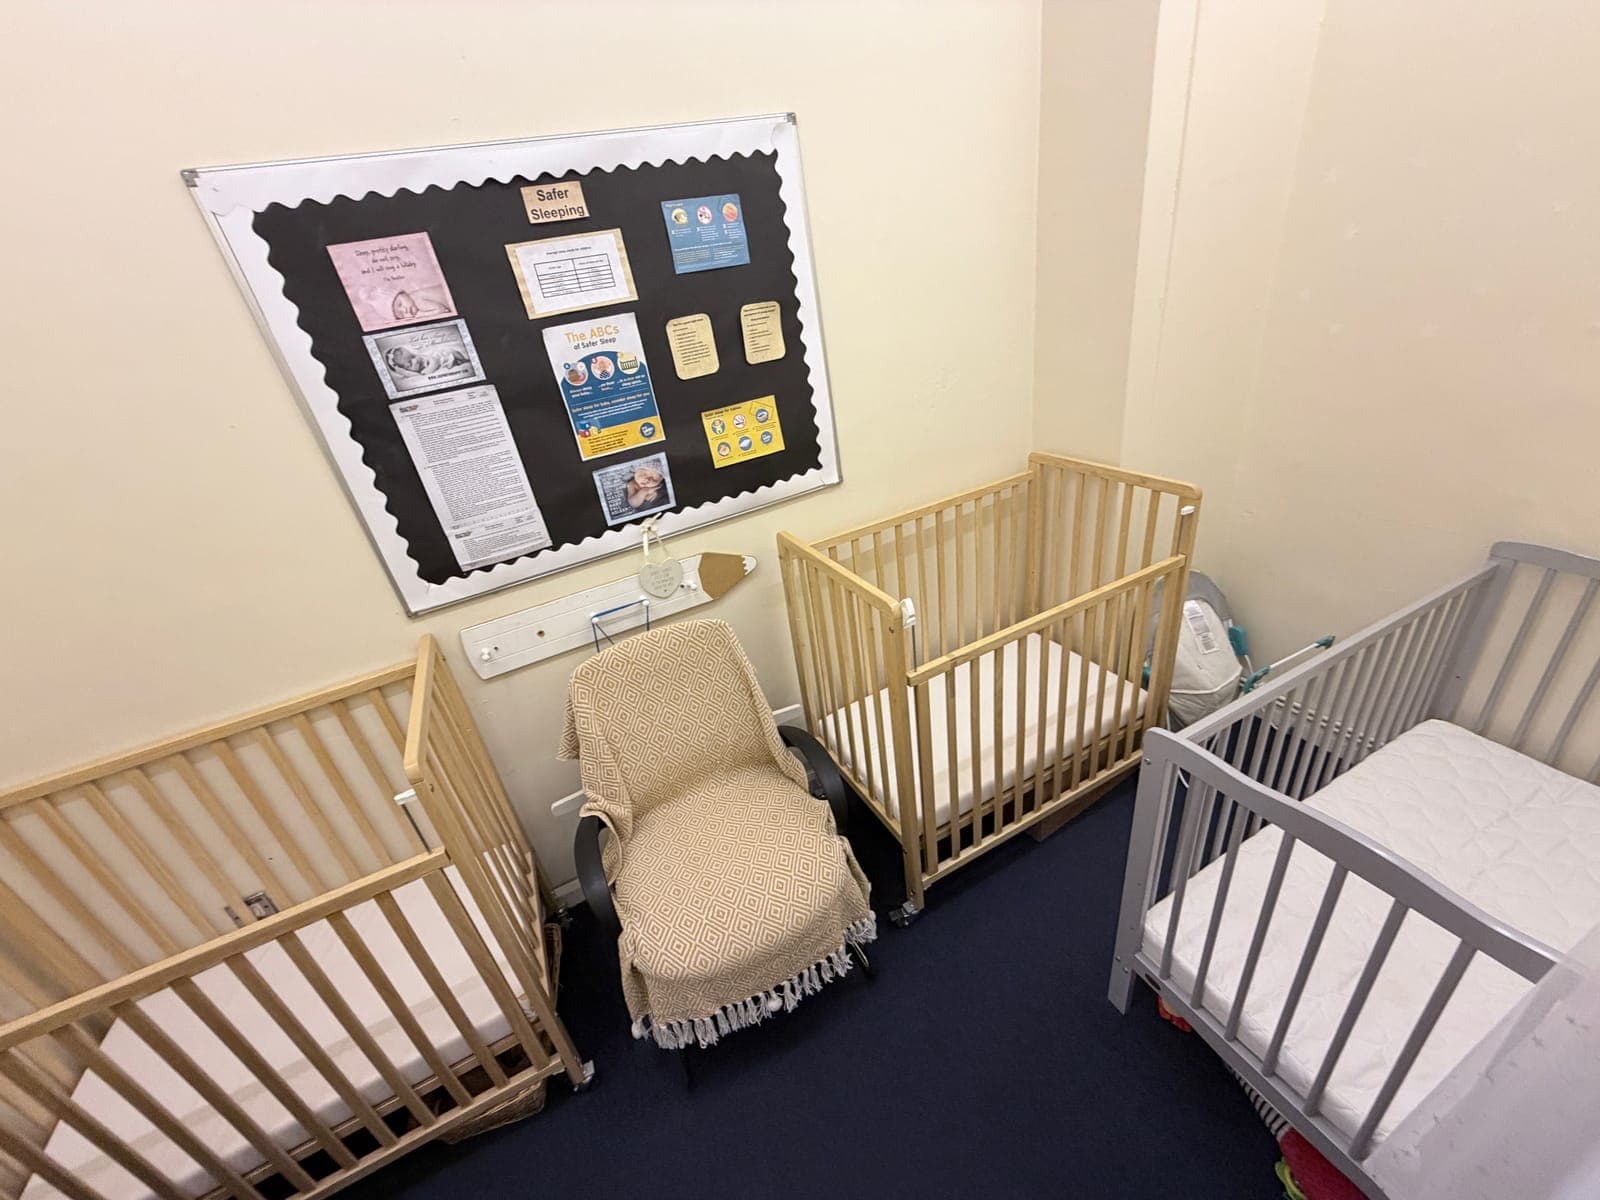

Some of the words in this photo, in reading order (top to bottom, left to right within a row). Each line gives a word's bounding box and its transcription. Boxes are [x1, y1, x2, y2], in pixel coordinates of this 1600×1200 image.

[536, 188, 569, 202] Safer
[530, 205, 585, 220] Sleeping
[564, 331, 587, 343] The
[590, 324, 620, 339] ABCs
[573, 342, 581, 350] of
[581, 339, 598, 349] Safer
[599, 336, 617, 345] Sleep
